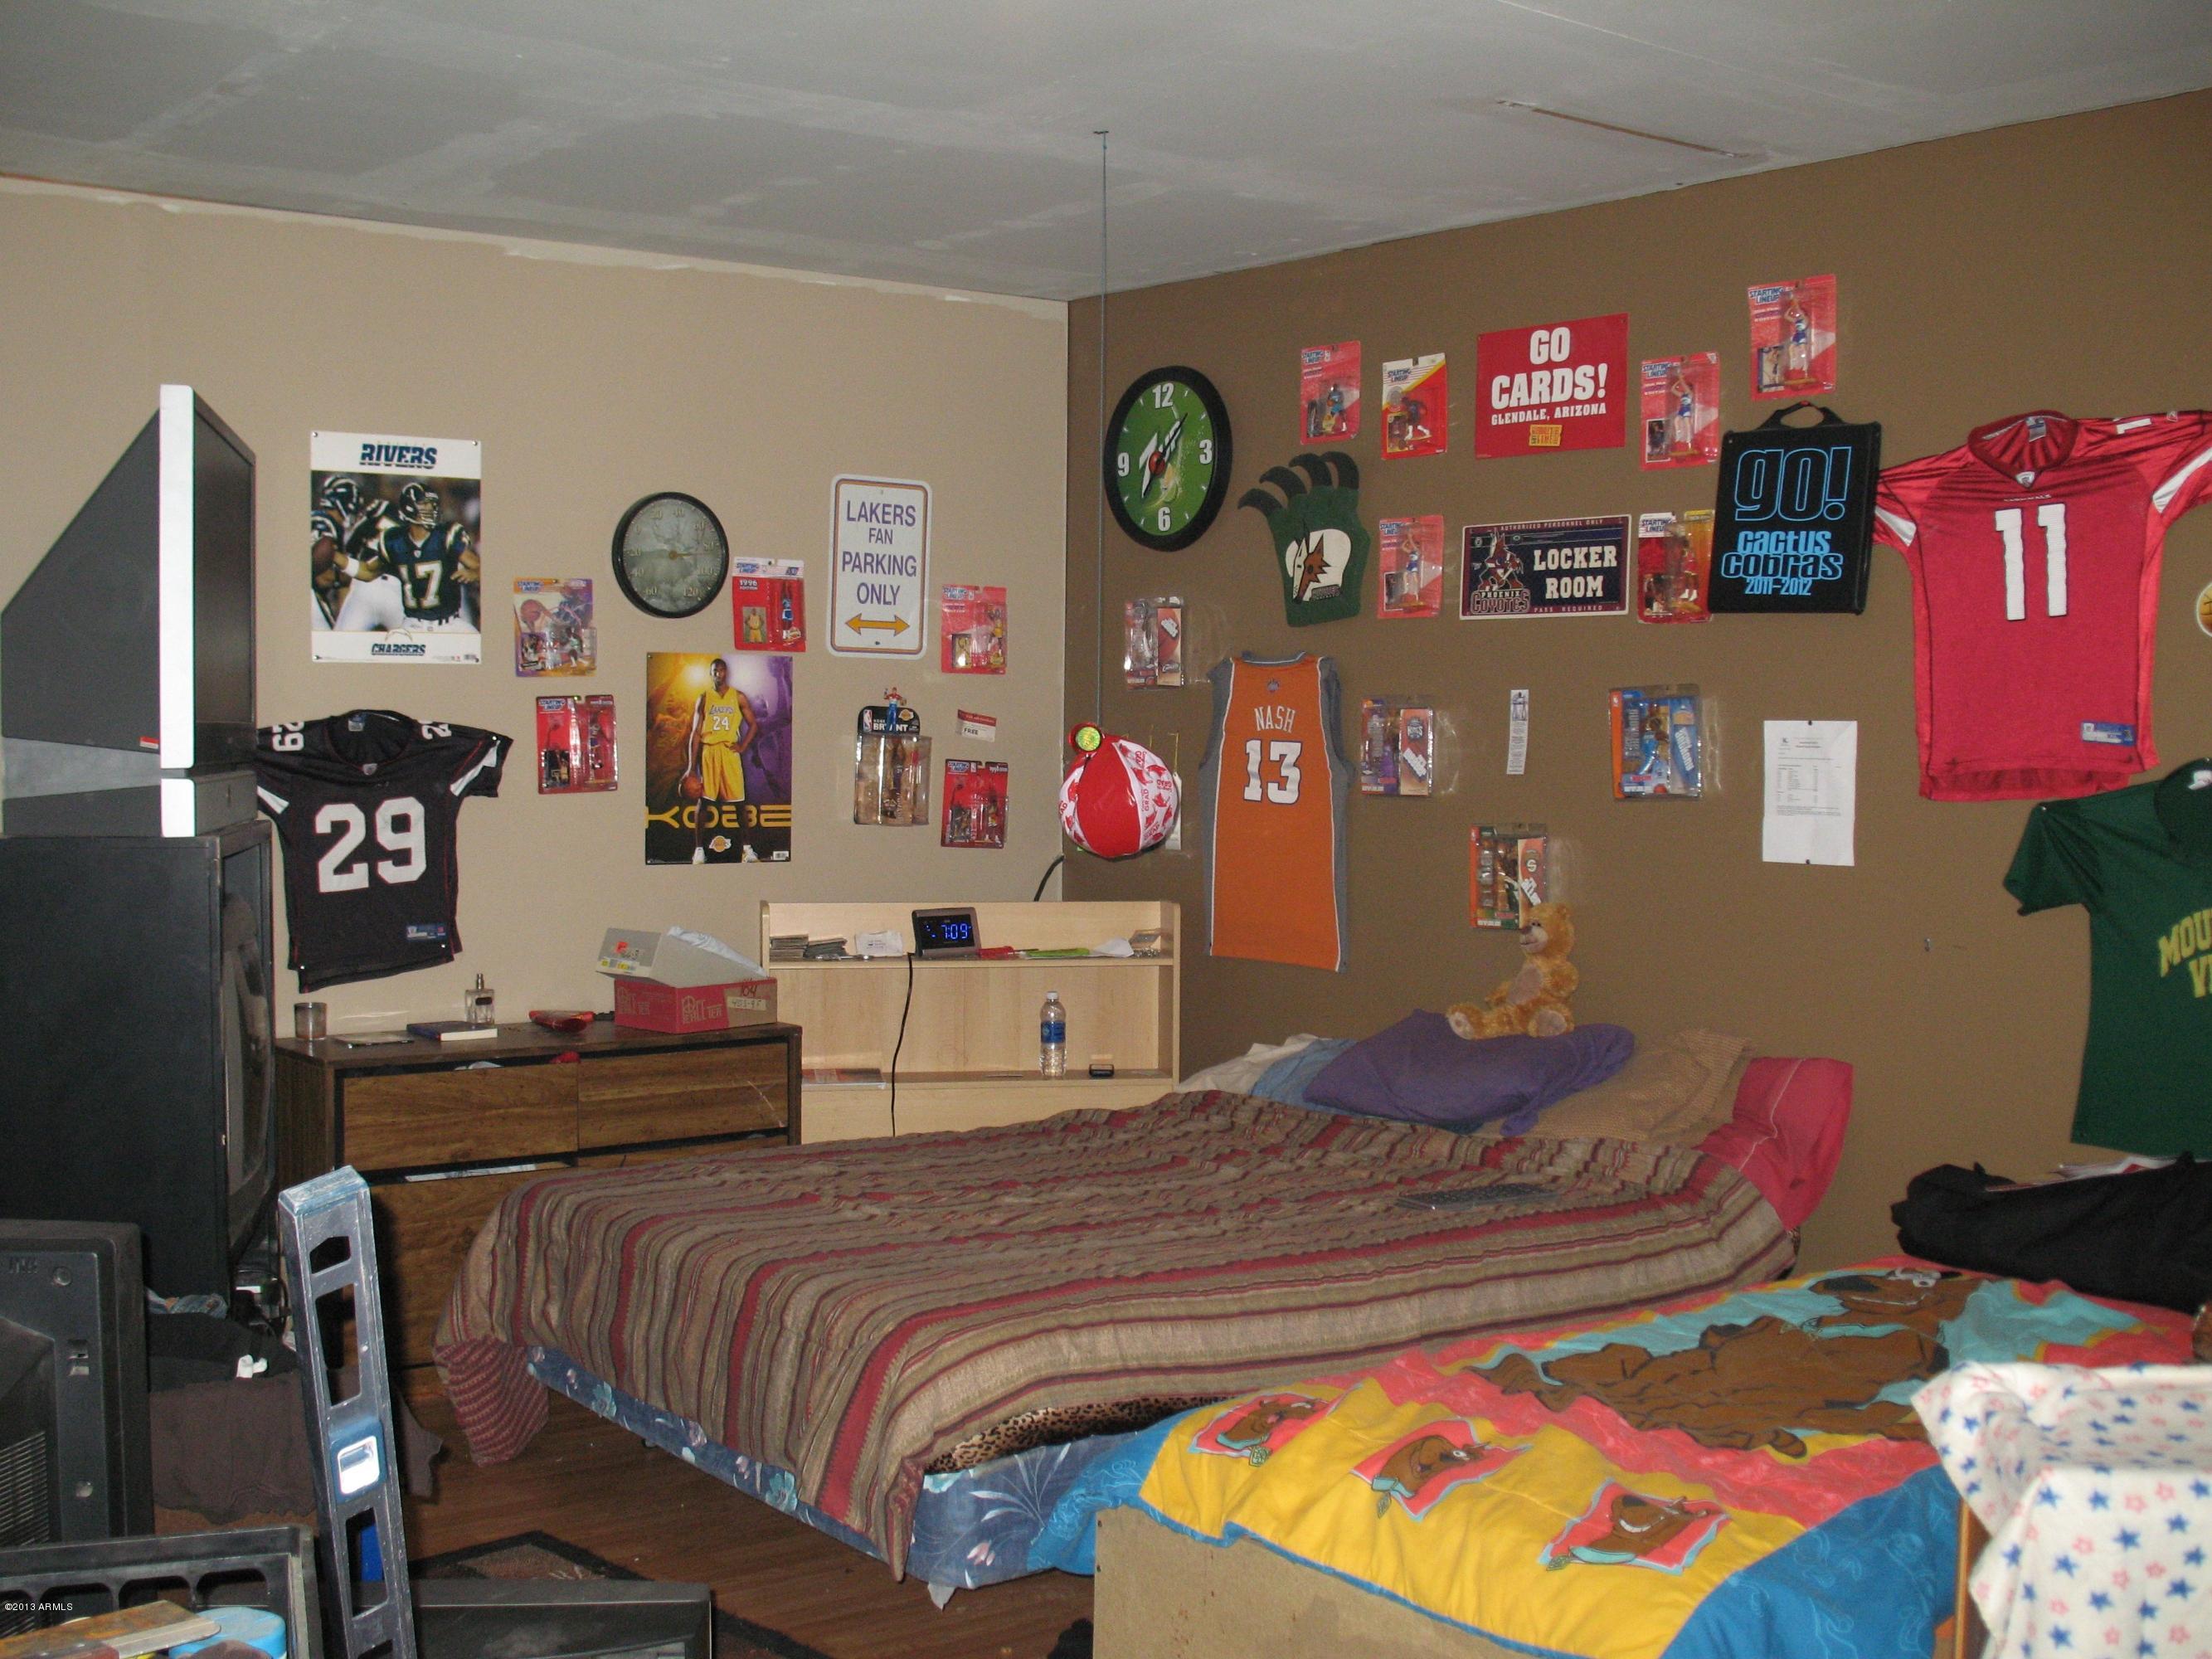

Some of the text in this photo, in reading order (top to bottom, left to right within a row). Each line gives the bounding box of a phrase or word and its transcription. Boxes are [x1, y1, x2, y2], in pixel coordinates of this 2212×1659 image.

[1749, 288, 1785, 298] STARTING
[1530, 327, 1571, 365] GO
[1152, 382, 1174, 409] 12
[1491, 362, 1608, 410] CARDS!
[1491, 402, 1607, 426] GLENDALE, ARIZONA
[361, 443, 438, 467] RIVERS
[1117, 453, 1130, 476] 9
[1199, 439, 1213, 465] 3
[1734, 446, 1852, 522] go!
[846, 500, 916, 527] LAKERS
[1158, 506, 1171, 532] 6
[1500, 522, 1541, 532] AUTHORIZED
[1544, 519, 1583, 529] PERSONNEL
[868, 528, 893, 545] FAN
[1737, 530, 1832, 555] cactus
[842, 551, 917, 577] PARKING
[1534, 545, 1617, 572] LOCKER
[1721, 552, 1844, 581] cobras
[1995, 504, 2067, 620] 11
[399, 561, 442, 609] 17
[857, 581, 901, 606] ONLY
[1545, 575, 1604, 599] ROOM
[1745, 577, 1813, 596] 2011-2012
[1471, 589, 1530, 614] COYOTES
[372, 643, 426, 656] CHARGERS
[713, 716, 730, 731] 24
[873, 722, 908, 732] BRNT
[1254, 705, 1296, 733] NASH
[1244, 739, 1302, 805] 13
[315, 796, 426, 893] 29
[941, 923, 969, 939] 7:09
